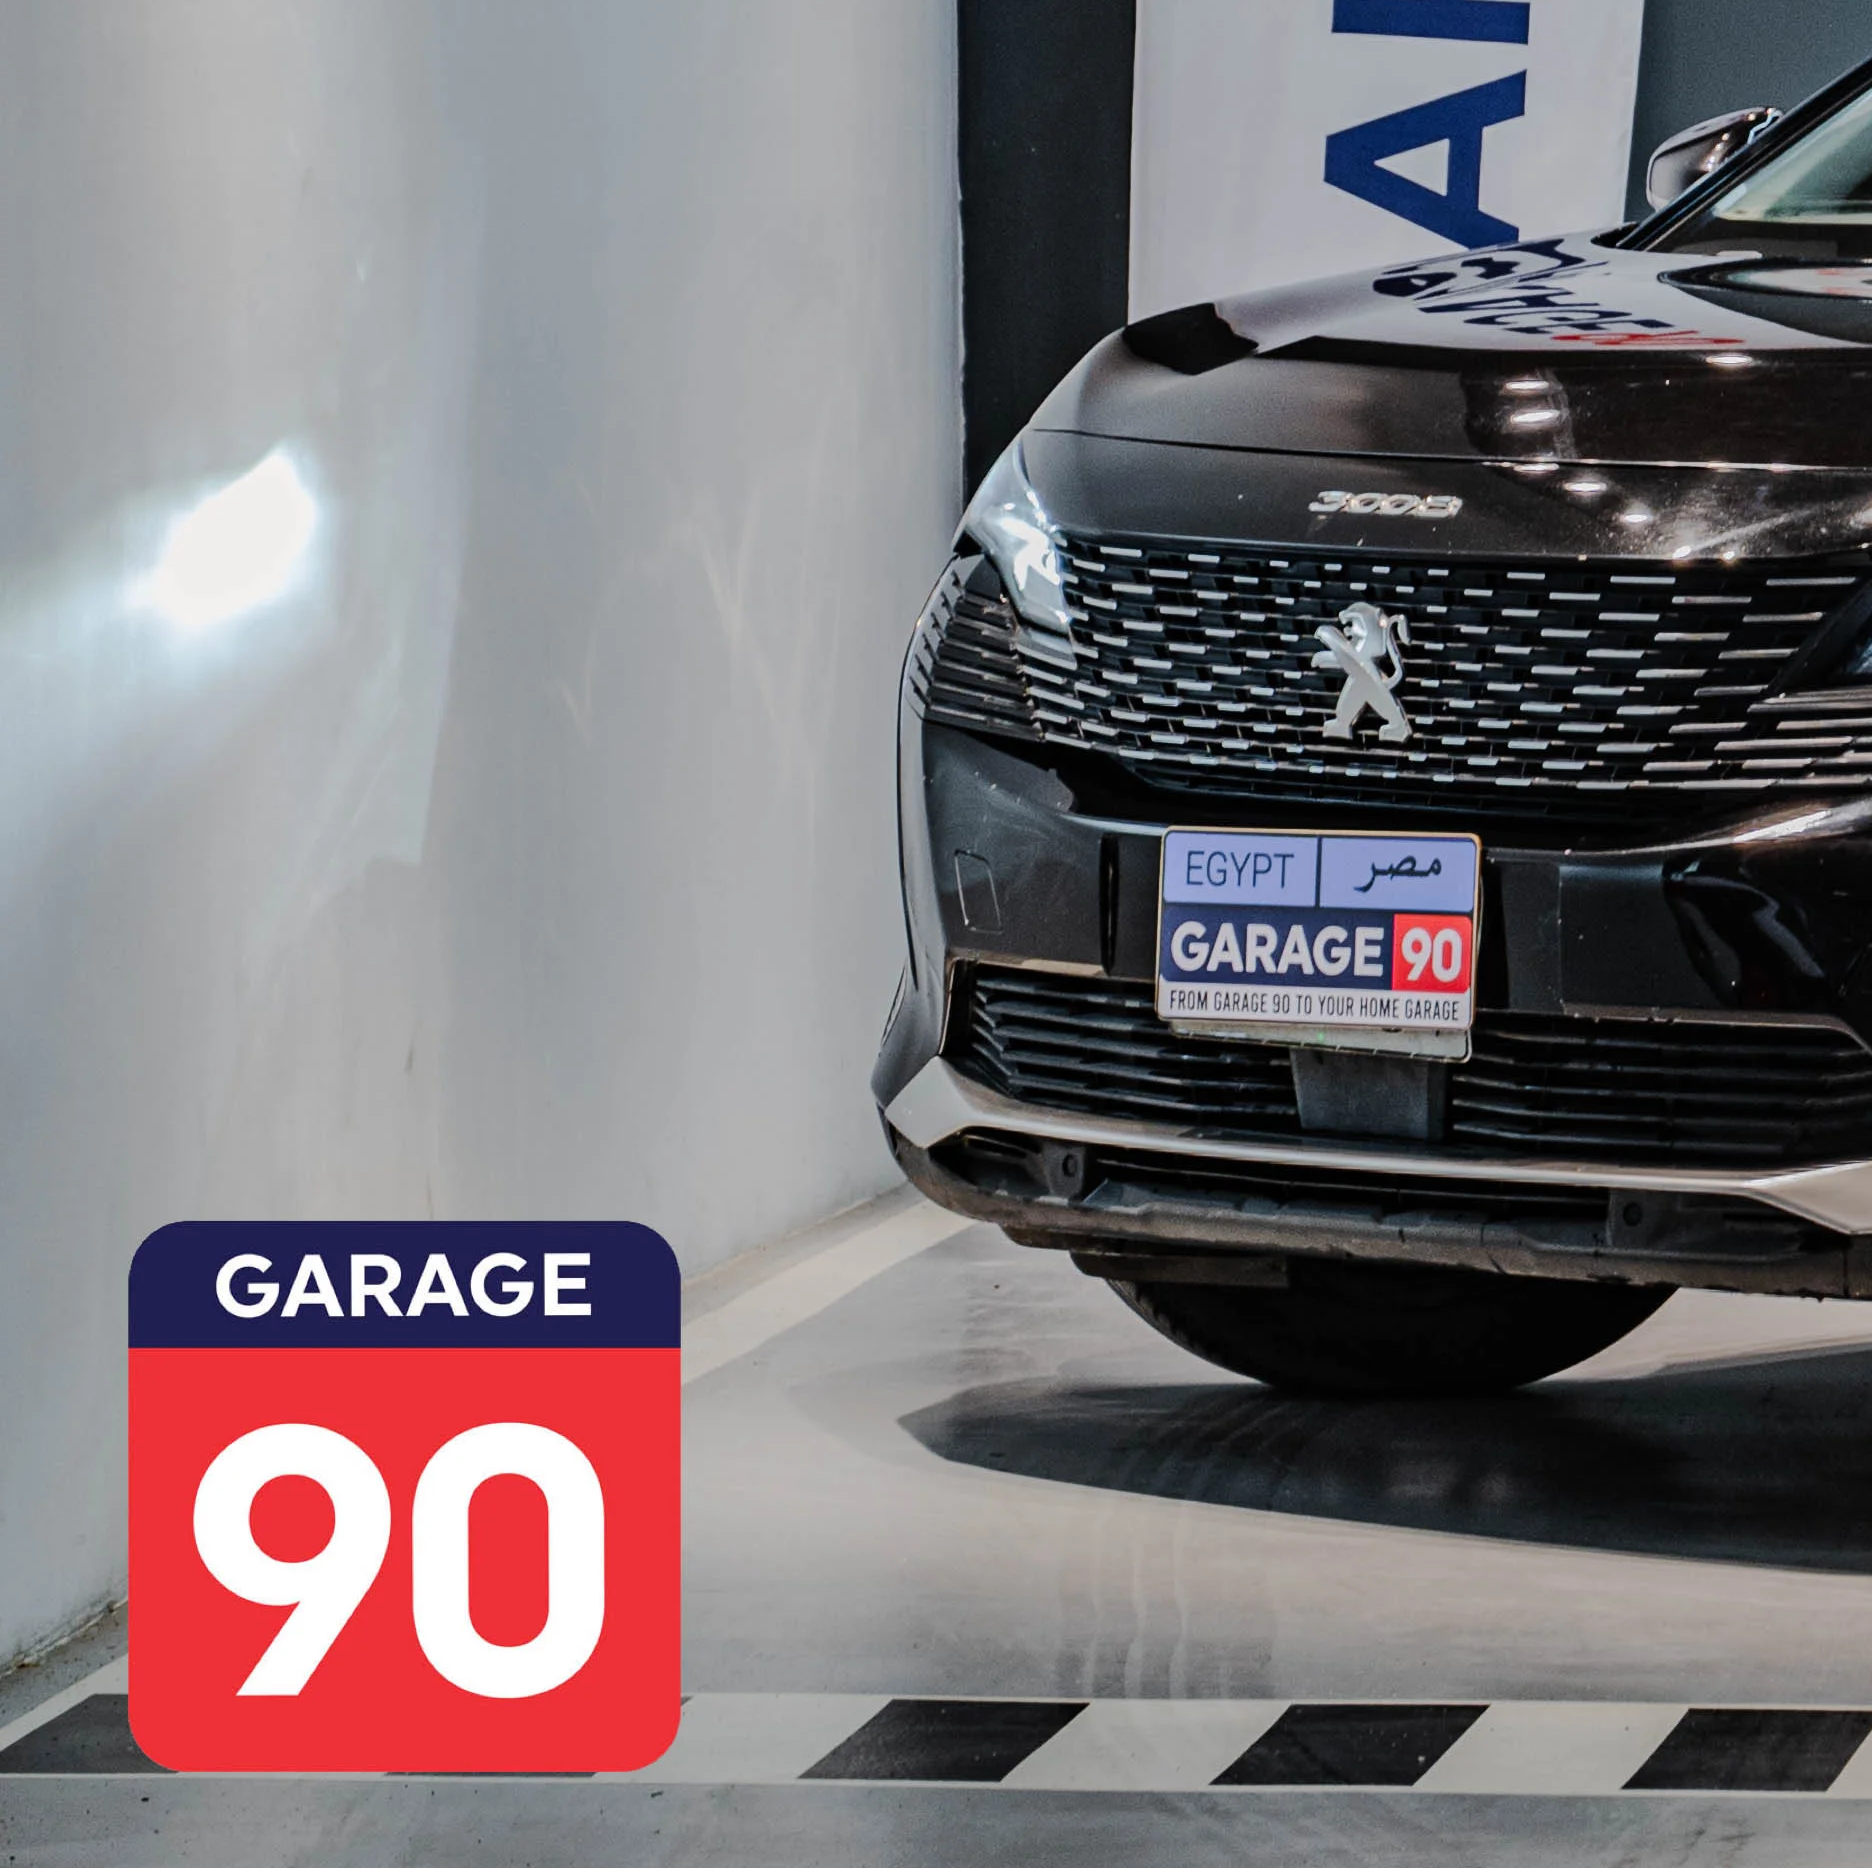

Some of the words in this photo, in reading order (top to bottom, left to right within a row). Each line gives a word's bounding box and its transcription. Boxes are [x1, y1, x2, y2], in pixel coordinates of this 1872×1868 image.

[1308, 490, 1463, 519] 3008
[1186, 851, 1295, 889] EGYPT
[1353, 855, 1442, 894] مصر
[1170, 921, 1384, 977] GARAGE
[1401, 927, 1462, 982] 90
[1169, 989, 1208, 1011] FROM
[1213, 991, 1268, 1013] GARAGE
[1272, 993, 1290, 1014] 90
[1296, 994, 1312, 1015] TO
[1318, 995, 1355, 1016] YOUR
[1360, 996, 1400, 1019] HOME
[1405, 999, 1459, 1021] GARAGE
